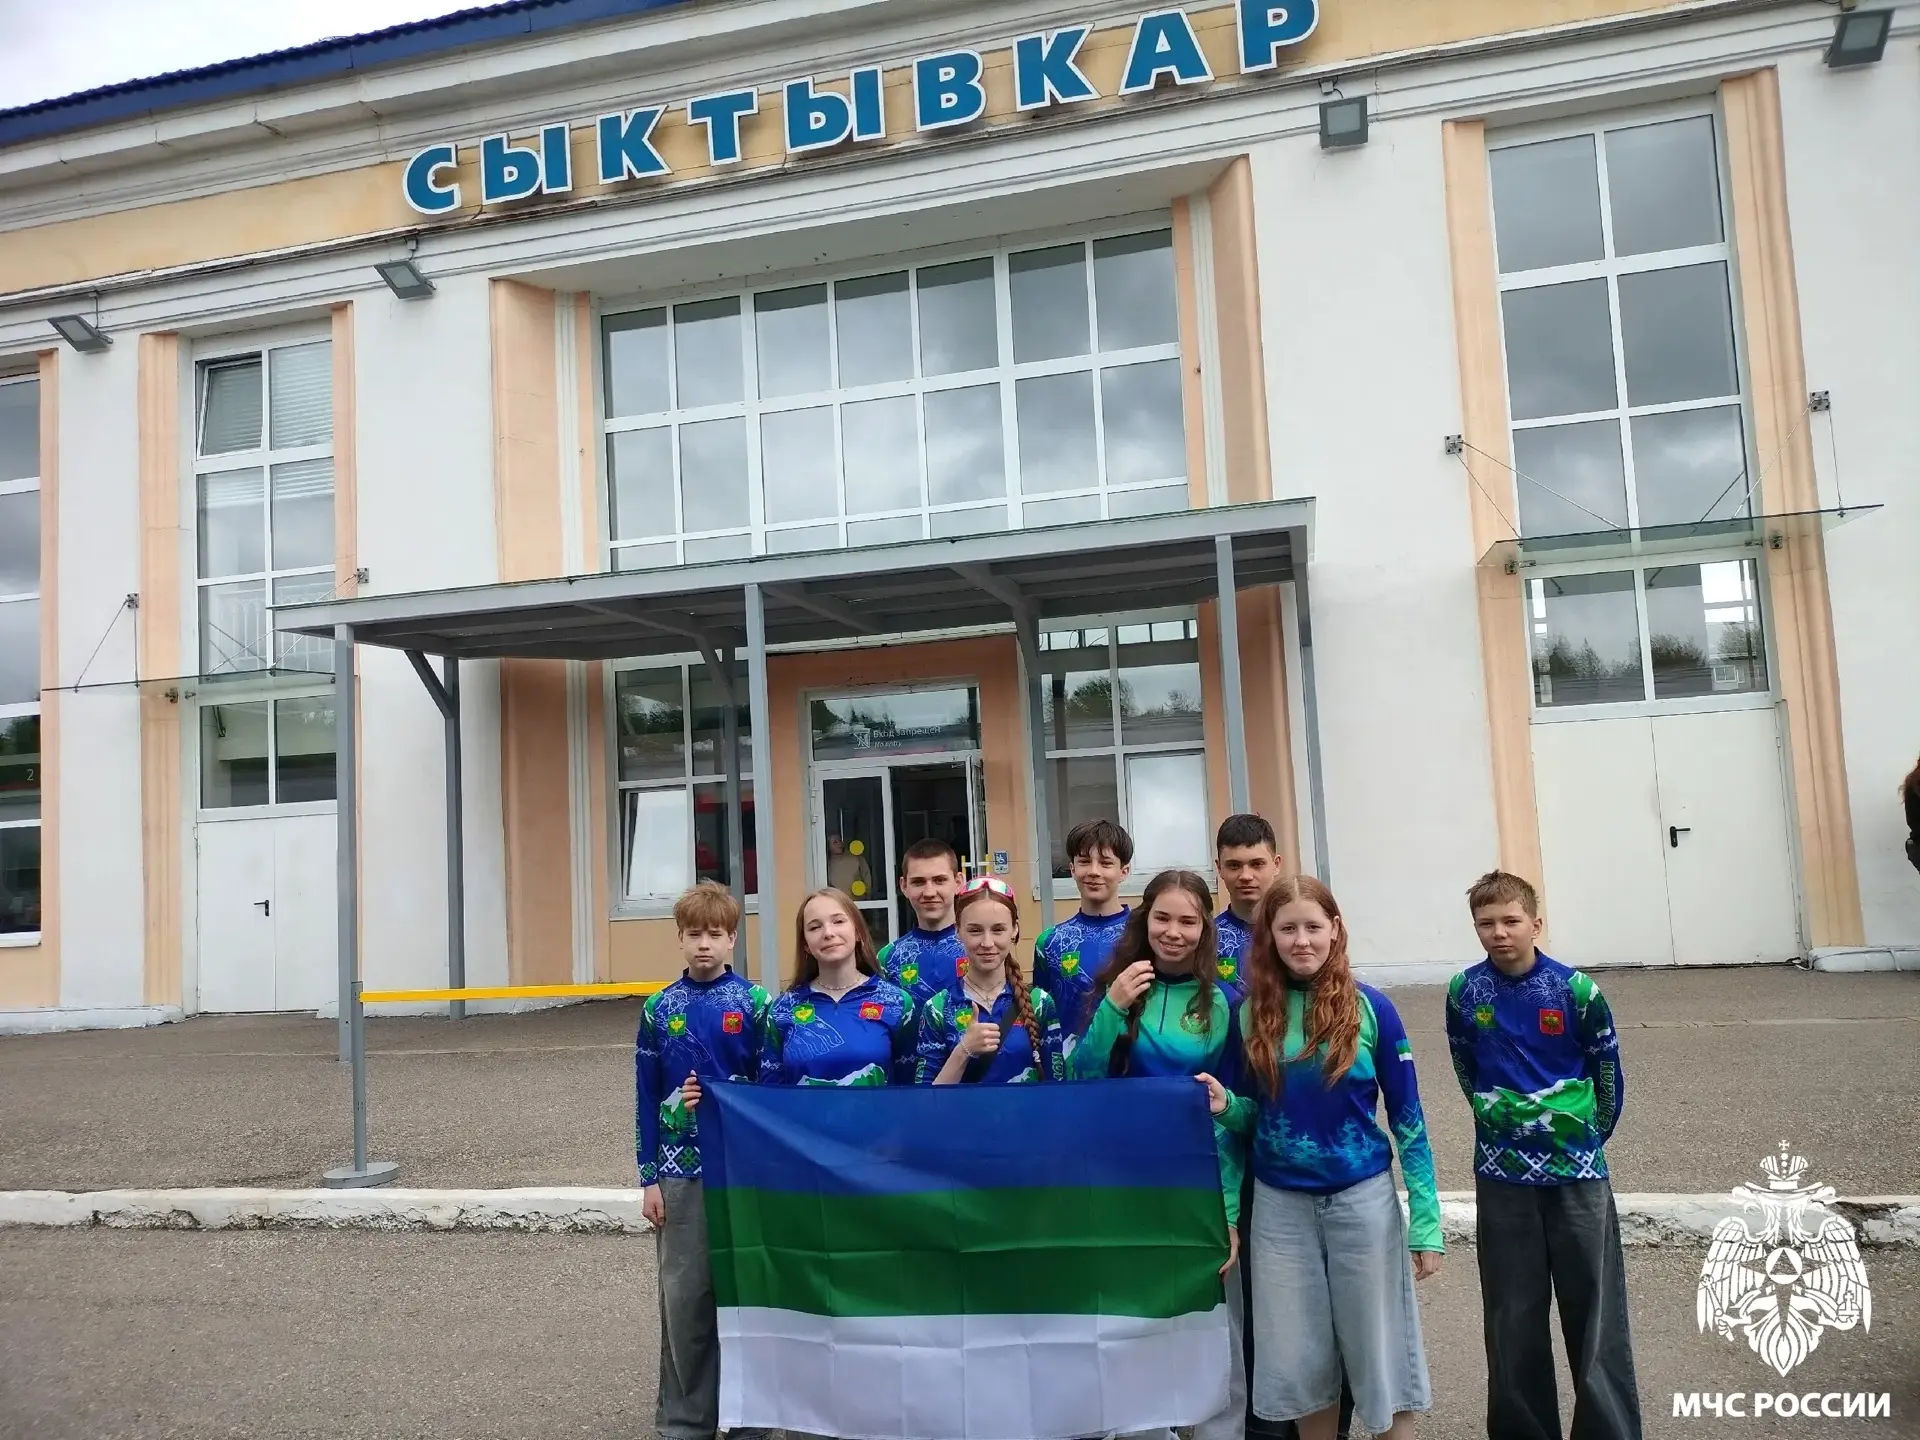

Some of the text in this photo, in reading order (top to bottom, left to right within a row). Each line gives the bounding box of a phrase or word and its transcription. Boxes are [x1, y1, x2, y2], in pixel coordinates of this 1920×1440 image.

[402, 0, 1320, 216] СЫКТЫВКАР
[873, 729, 895, 739] Вход
[874, 741, 884, 749] No
[26, 768, 34, 781] 2
